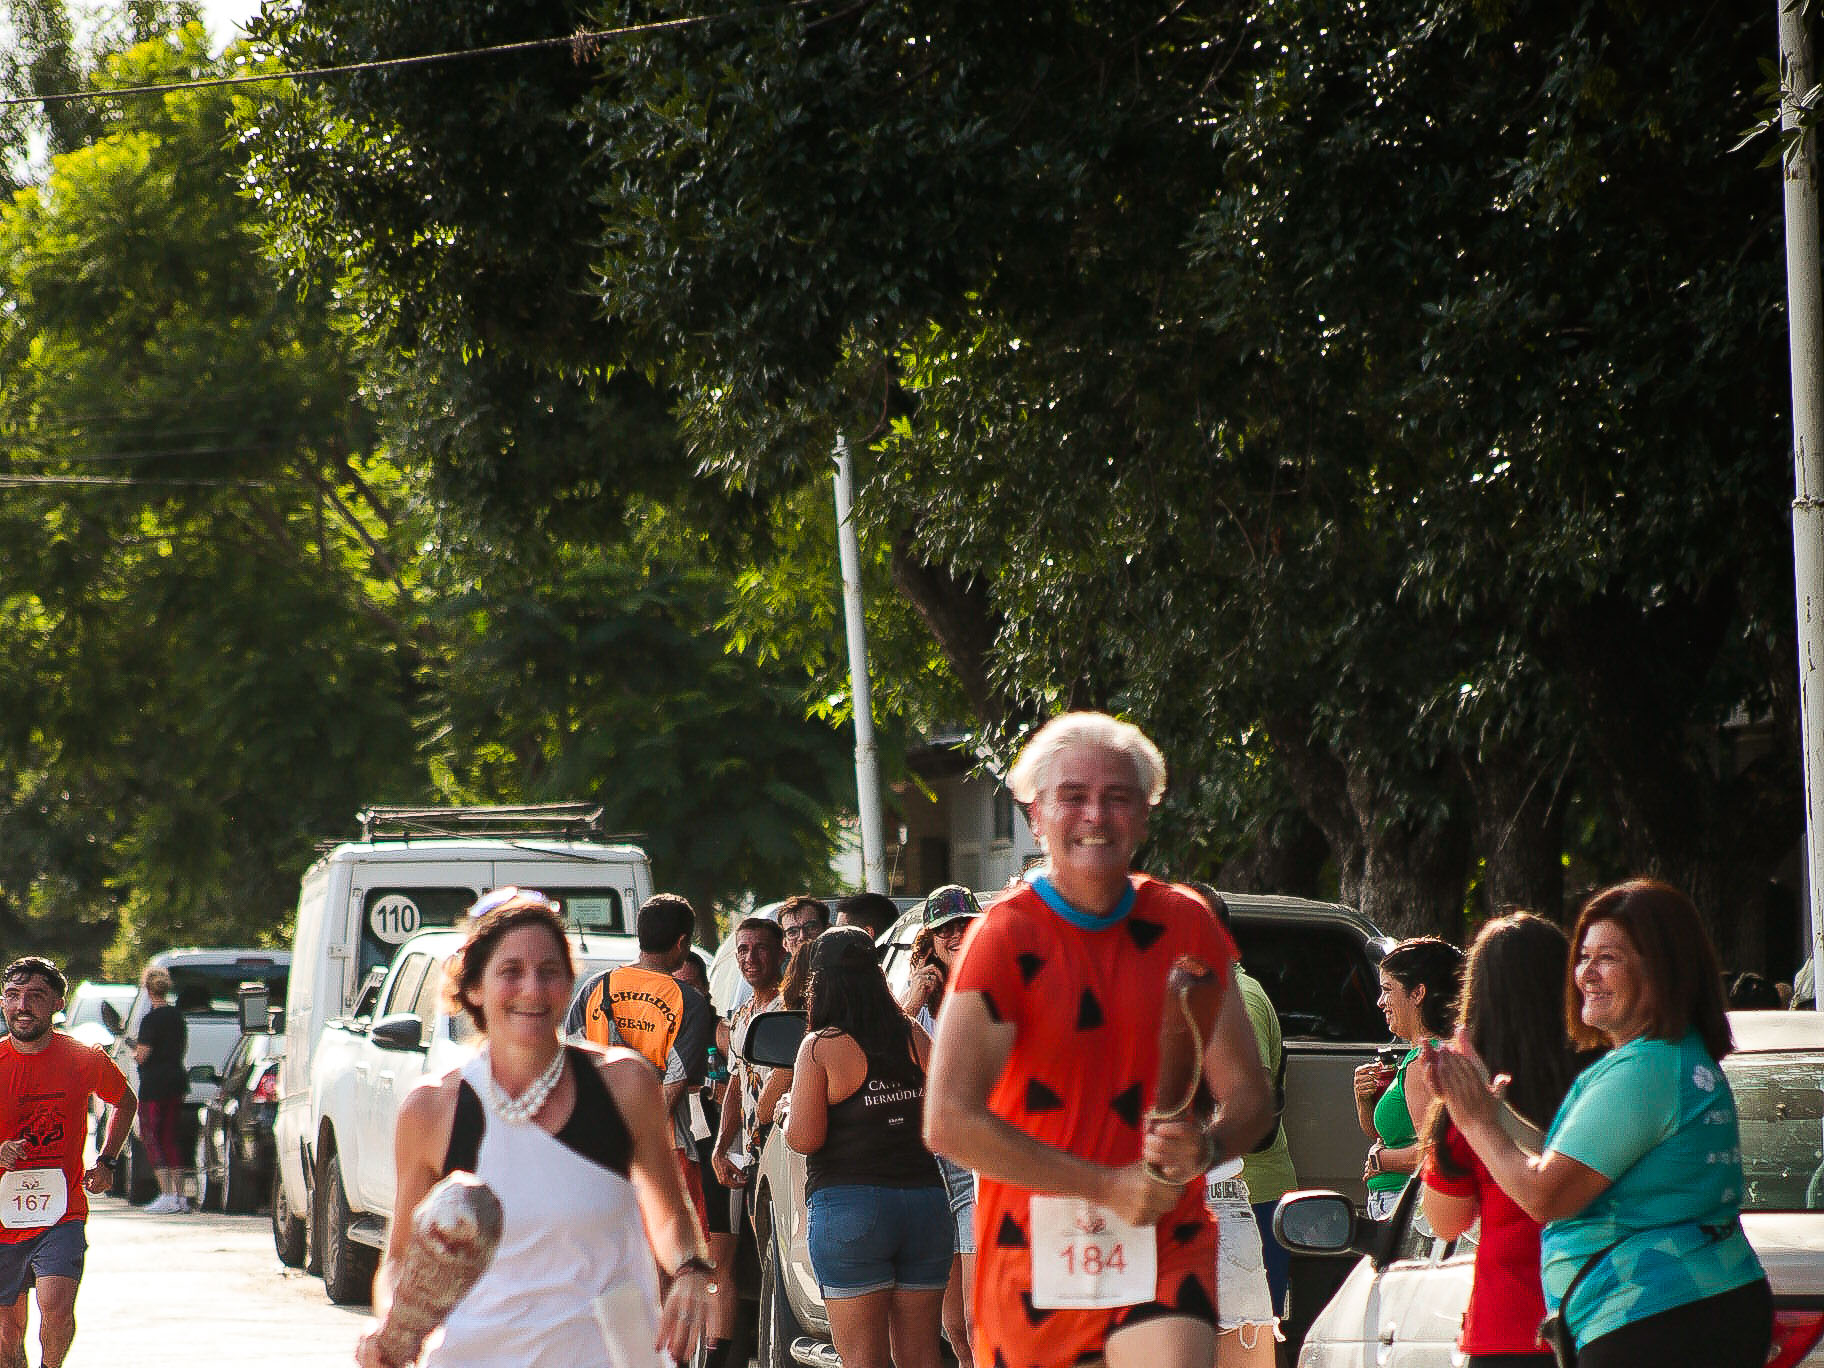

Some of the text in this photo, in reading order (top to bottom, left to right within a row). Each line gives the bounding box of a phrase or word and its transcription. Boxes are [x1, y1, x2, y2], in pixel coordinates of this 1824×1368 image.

[377, 904, 415, 933] 110
[12, 1194, 51, 1211] 167
[1059, 1243, 1127, 1275] 184
